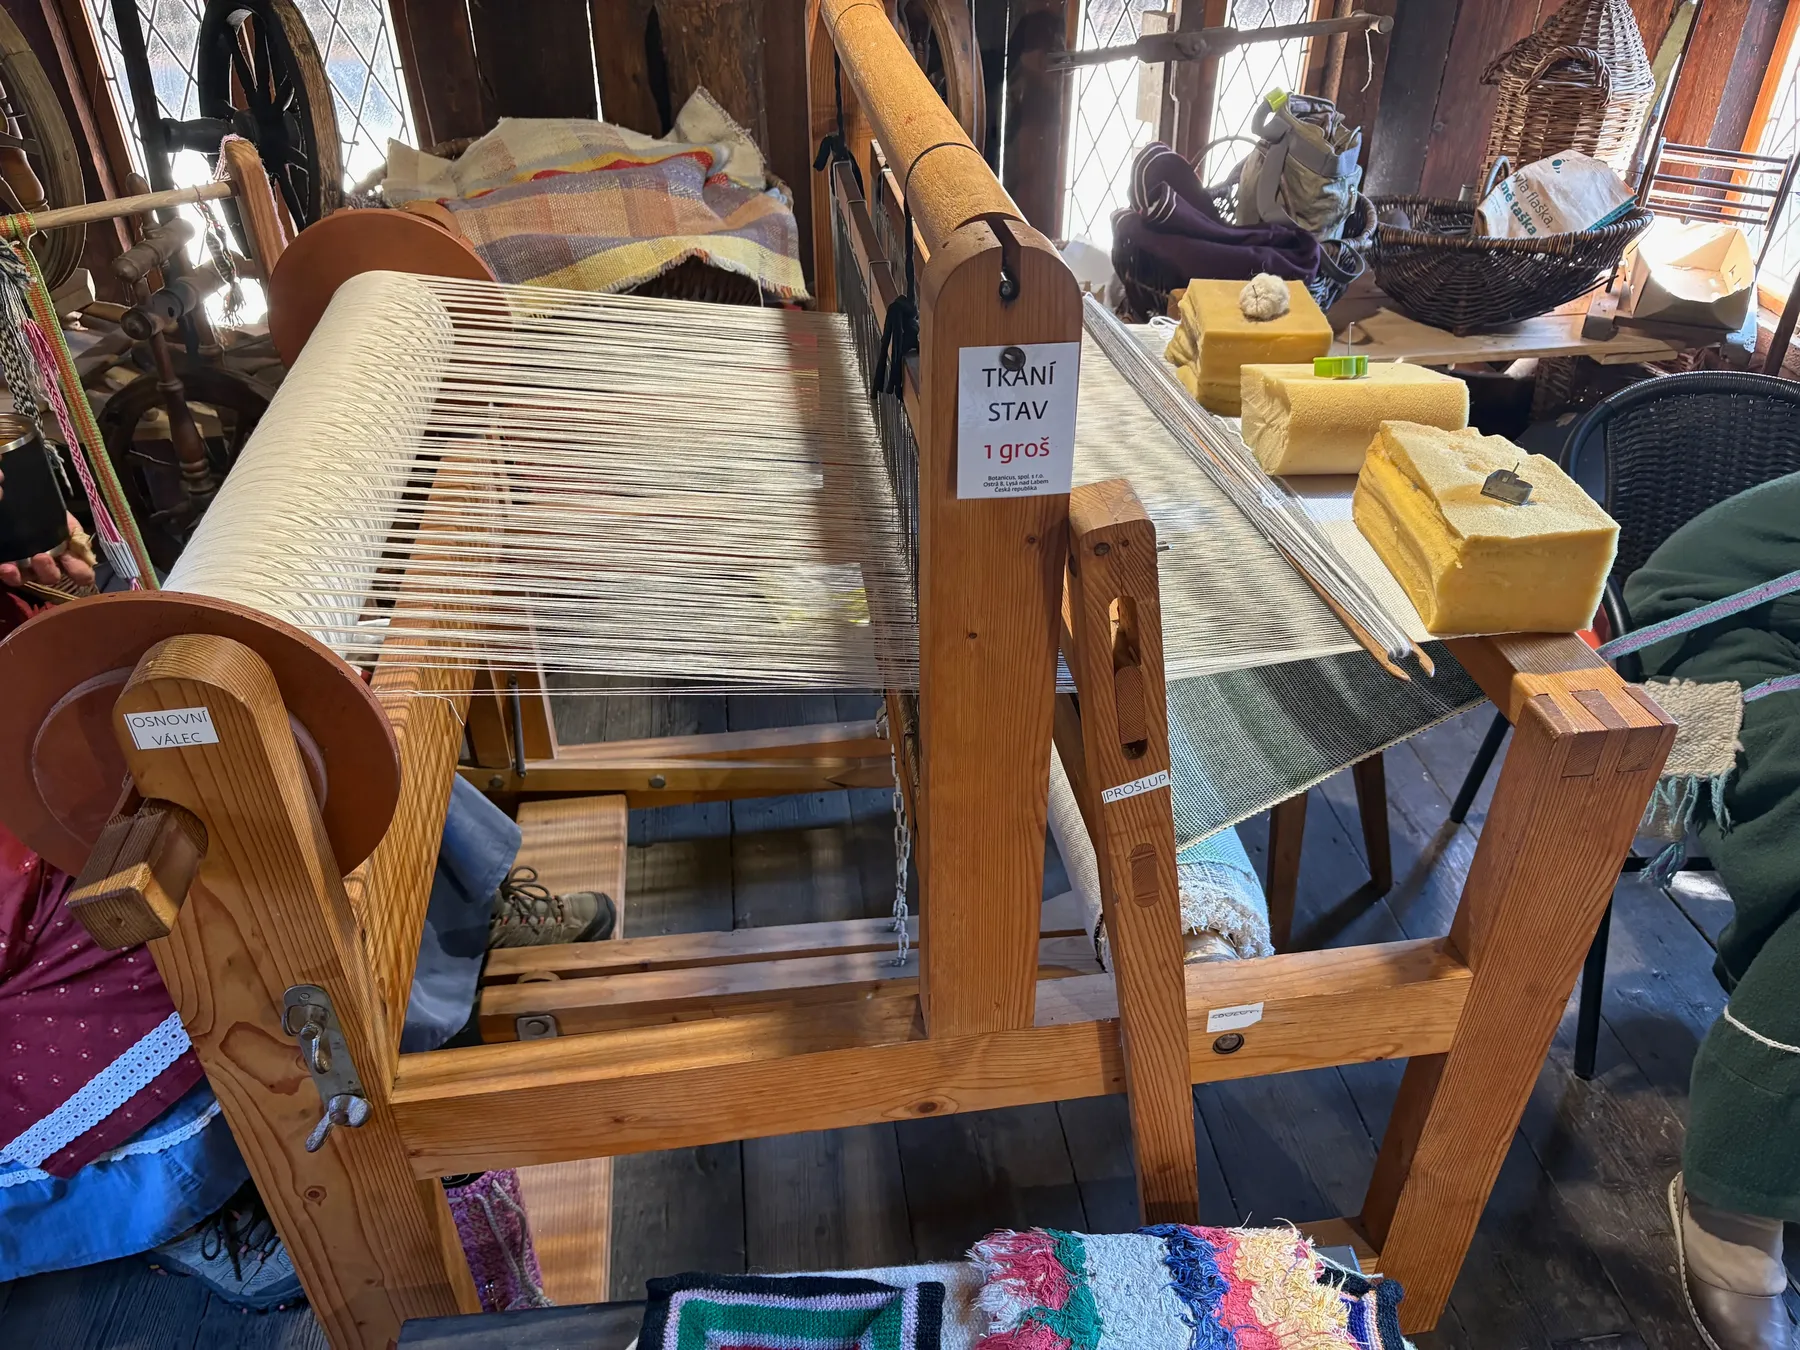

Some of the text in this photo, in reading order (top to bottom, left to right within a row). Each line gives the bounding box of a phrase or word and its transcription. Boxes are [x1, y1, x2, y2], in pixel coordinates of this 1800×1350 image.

[1510, 201, 1537, 236] taška
[1526, 192, 1554, 228] flaška,
[982, 361, 1057, 387] TKANÍ
[988, 400, 1049, 422] STAV
[984, 436, 1050, 464] 1 groš
[132, 710, 208, 728] OSNOVNÍ
[152, 732, 202, 746] VÁLEC
